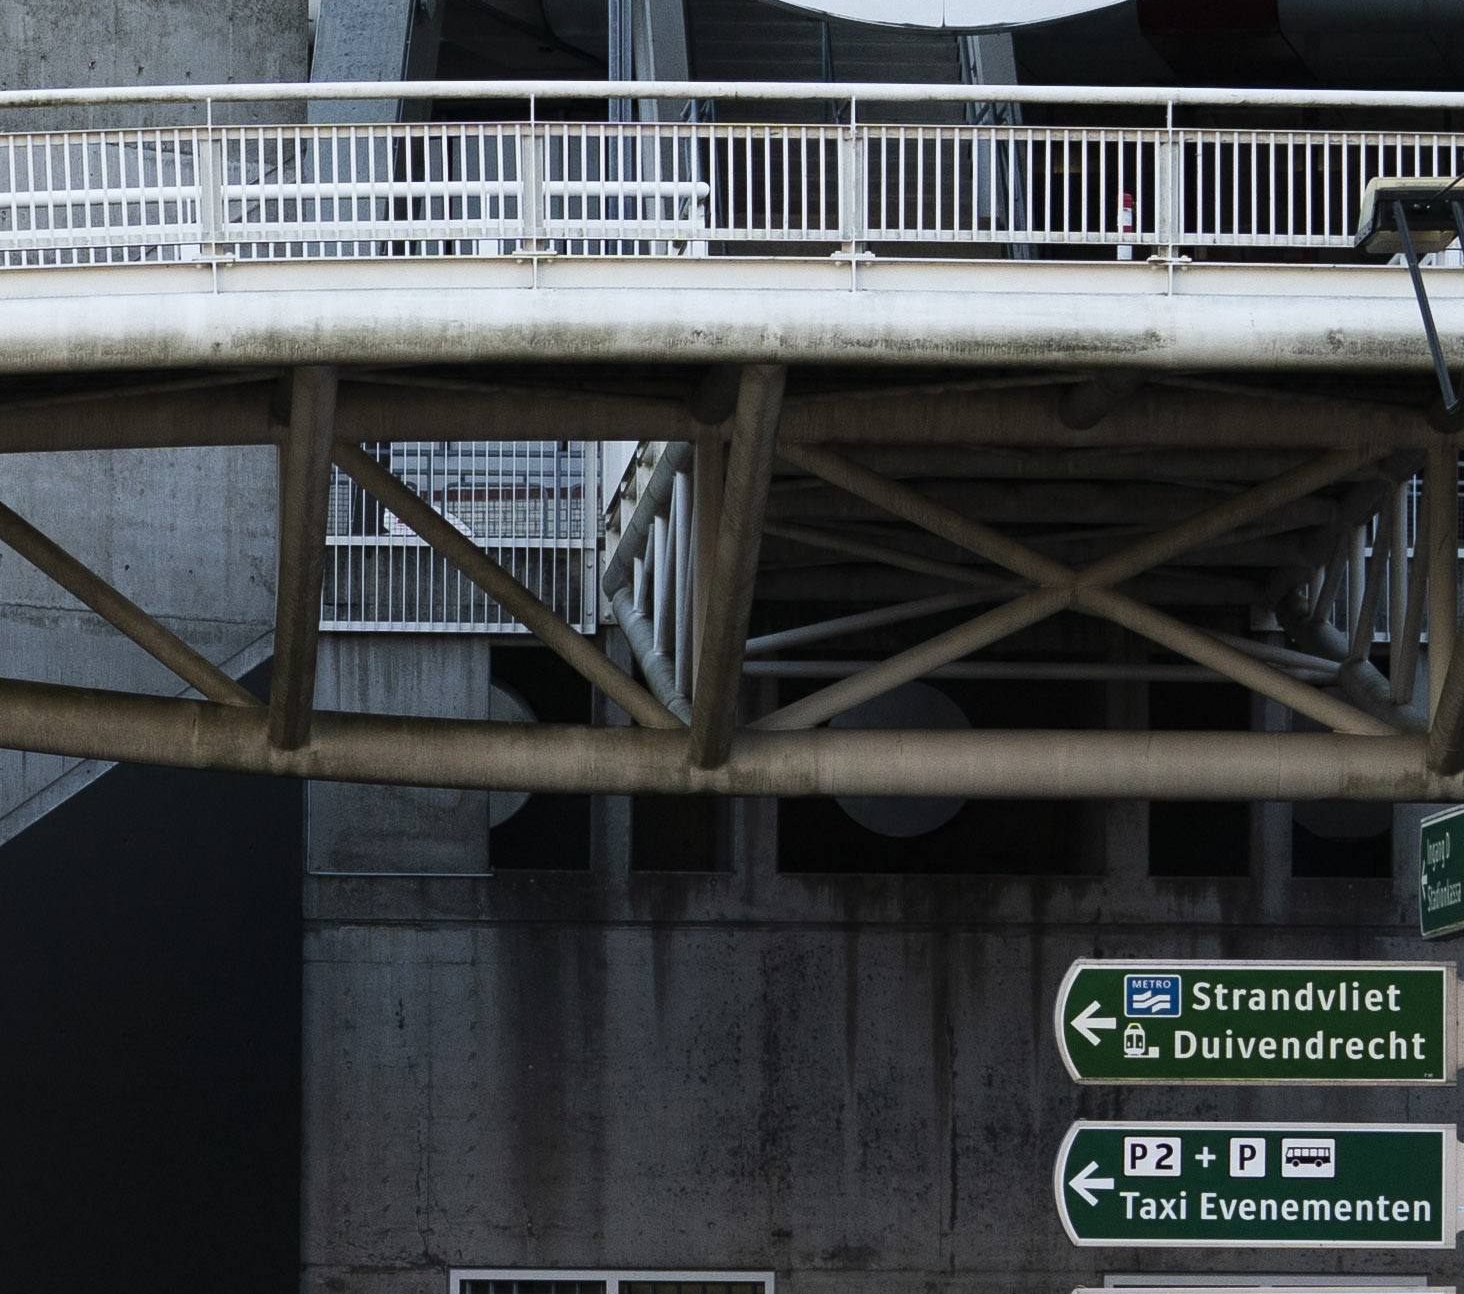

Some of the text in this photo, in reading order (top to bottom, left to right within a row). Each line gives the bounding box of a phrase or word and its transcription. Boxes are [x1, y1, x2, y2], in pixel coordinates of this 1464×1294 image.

[1426, 838, 1445, 872] Ingang
[1427, 878, 1462, 912] Stadionkassa
[1132, 979, 1172, 989] METRO
[1191, 981, 1401, 1012] Strandvliet
[1174, 1029, 1426, 1060] Duivendrecht
[1130, 1143, 1174, 1171] P2
[1239, 1144, 1257, 1171] P
[1119, 1191, 1431, 1222] Taxi Evenementen
